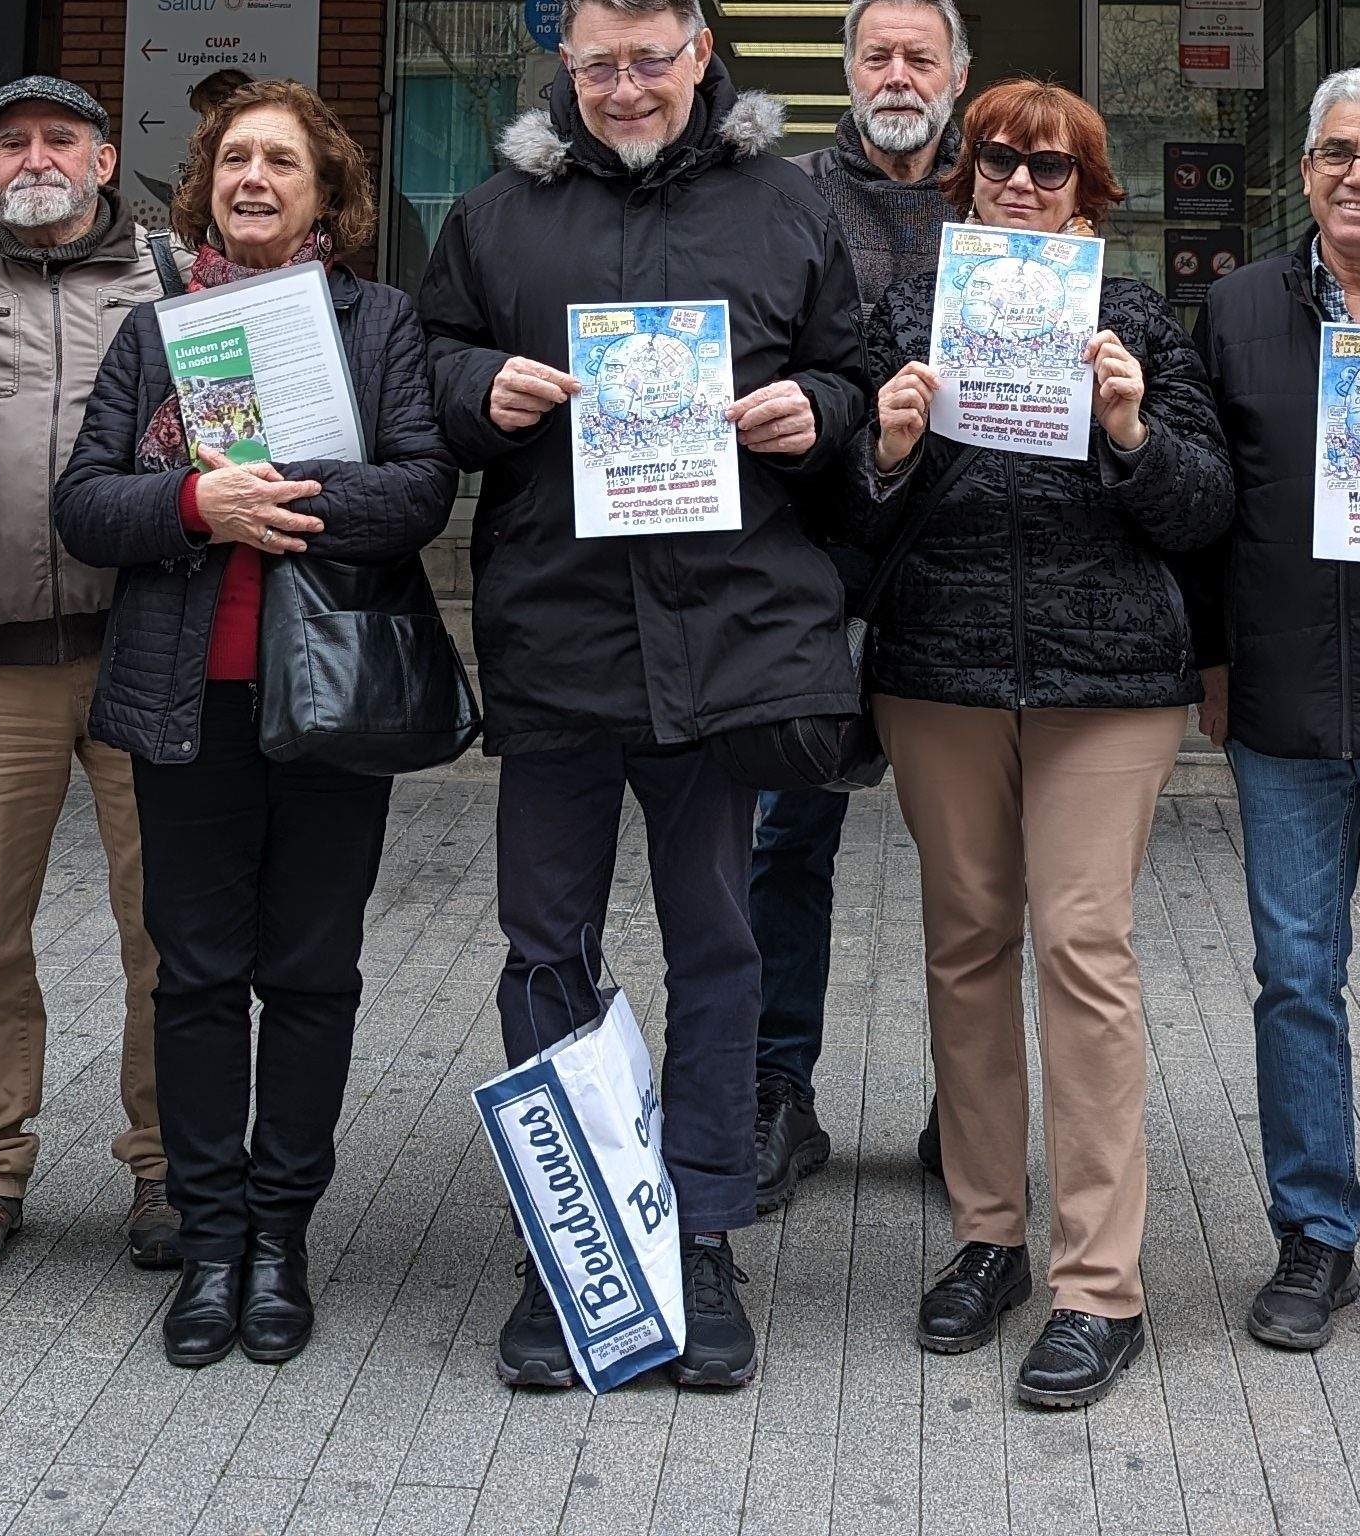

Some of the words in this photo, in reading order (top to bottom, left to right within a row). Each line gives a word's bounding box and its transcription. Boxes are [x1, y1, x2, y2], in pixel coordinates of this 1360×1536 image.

[536, 25, 551, 33] no
[205, 38, 240, 48] CUAP
[178, 52, 238, 65] Urgències
[242, 53, 256, 63] 24
[260, 52, 267, 63] h
[174, 342, 219, 359] Lluitem
[221, 337, 240, 352] per
[177, 360, 186, 371] la
[188, 354, 218, 368] nostra
[220, 348, 243, 361] salut
[960, 380, 1032, 394] MANIFESTACIÓ
[1037, 384, 1043, 392] 7
[962, 413, 1022, 427] Coordinadora
[958, 422, 971, 431] per
[981, 424, 1008, 433] Sanitat
[1010, 427, 1037, 437] Pública
[1051, 432, 1068, 440] Rubí
[1013, 437, 1052, 447] entitats
[606, 460, 677, 479] MANIFESTACIÓ
[682, 460, 689, 470] 7
[612, 498, 672, 508] Coordinadora
[609, 512, 621, 521] per
[661, 506, 688, 516] Pública
[702, 504, 719, 513] Rubí
[519, 1105, 627, 1322] Bendranas
[613, 1324, 649, 1343] Barcelona,
